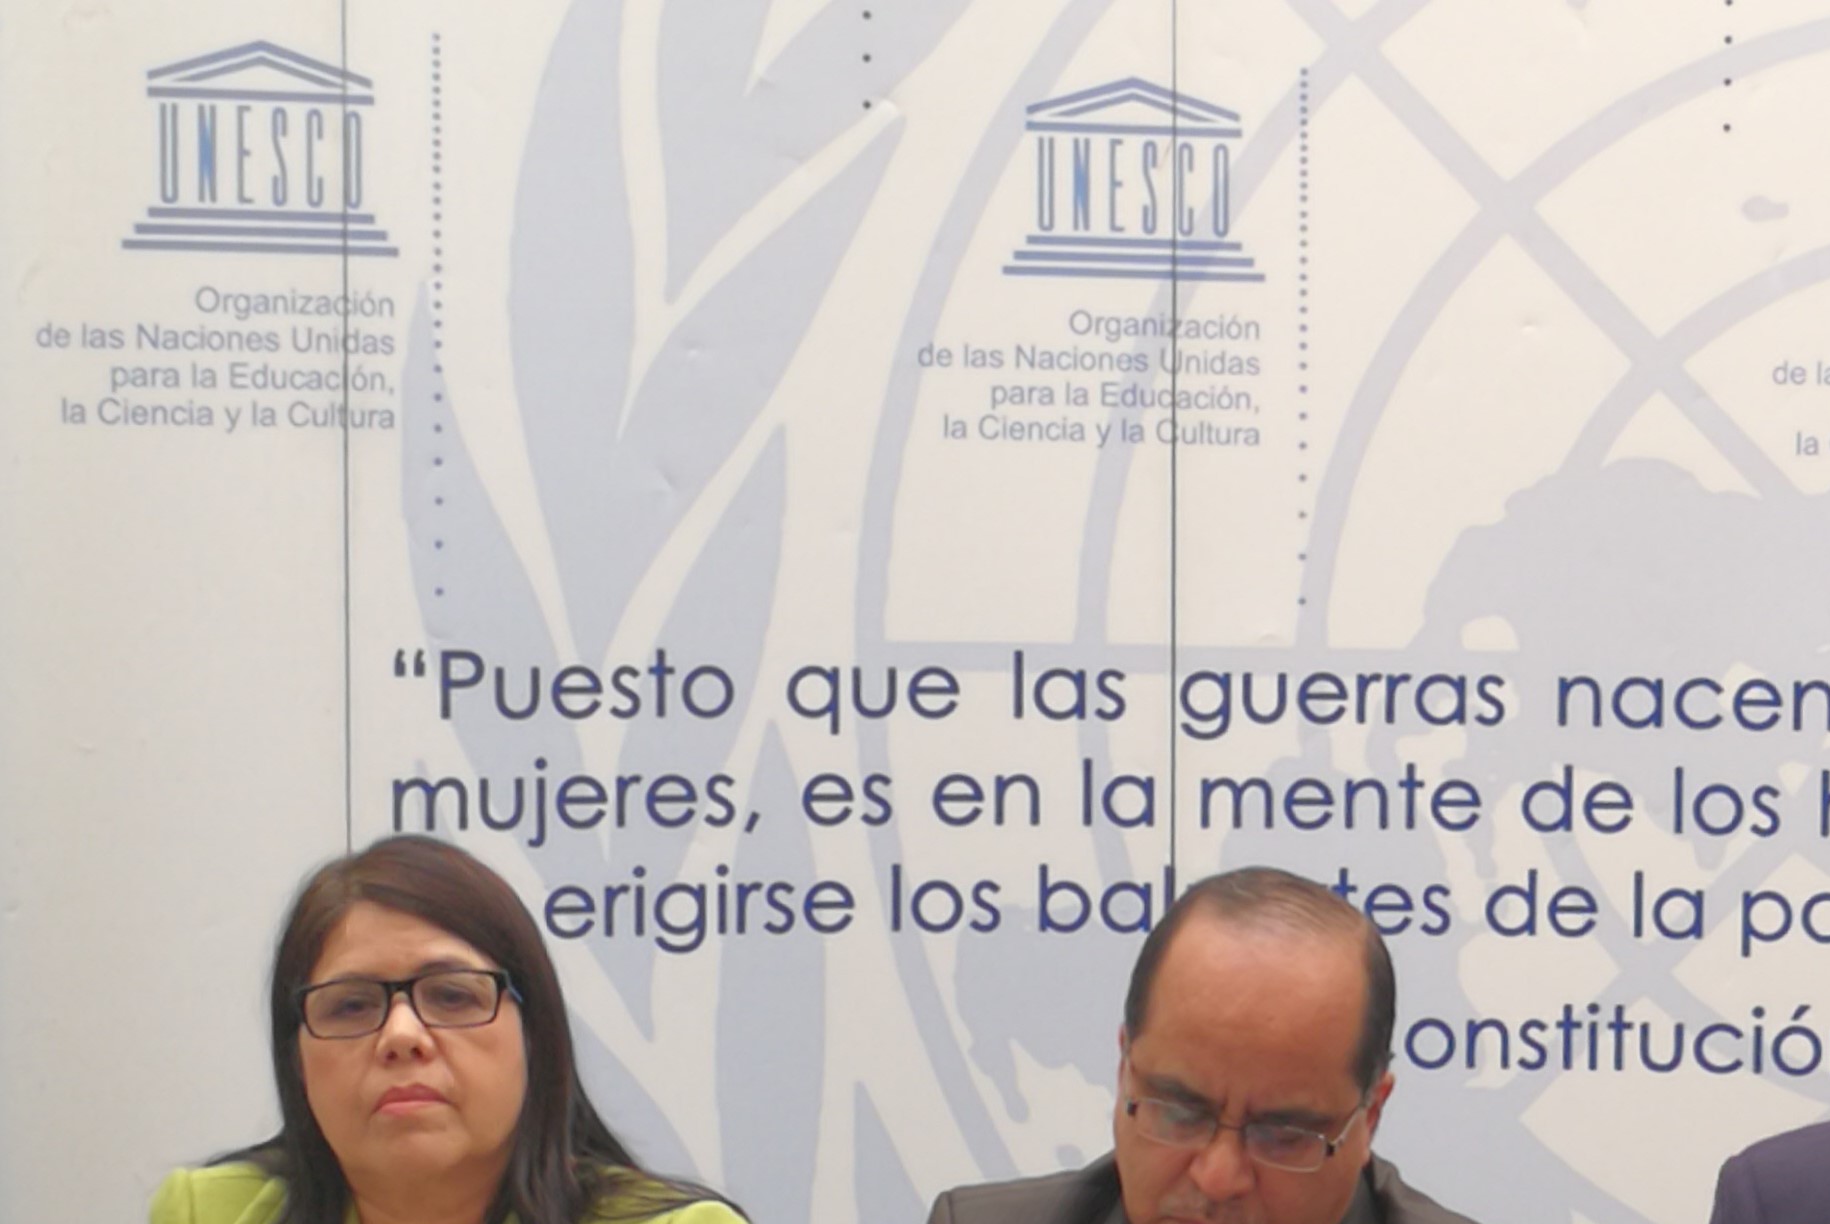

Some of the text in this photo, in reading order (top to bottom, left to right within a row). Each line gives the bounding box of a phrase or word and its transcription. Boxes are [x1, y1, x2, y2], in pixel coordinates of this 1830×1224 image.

[158, 104, 363, 209] UNESCO
[1037, 137, 1230, 238] UNESCO
[195, 284, 395, 320] Organización
[36, 321, 395, 355] de las Naciones Unidas
[1069, 309, 1260, 341] Organización
[917, 342, 1260, 376] de las Naciones Unidas
[1773, 361, 1807, 387] de
[110, 360, 395, 395] para la Educación,
[990, 379, 1260, 414] para la Educación,
[61, 398, 395, 433] la Ciencia y la Cultura
[943, 414, 1260, 449] la Ciencia y la Cultura
[1795, 433, 1819, 457] la
[393, 649, 734, 719] “Puesto
[786, 662, 961, 735] que
[1012, 651, 1127, 719] las
[1180, 668, 1504, 740] guerras
[391, 757, 761, 848] mujeres,
[802, 772, 893, 827] es
[932, 771, 1040, 827] en
[1082, 758, 1155, 827] la
[1200, 762, 1482, 831] mente
[1521, 764, 1634, 835] de
[1673, 766, 1779, 837] los
[544, 866, 854, 954] erigirse
[891, 864, 1001, 934] los
[1486, 870, 1598, 939] de
[1634, 871, 1706, 941] la
